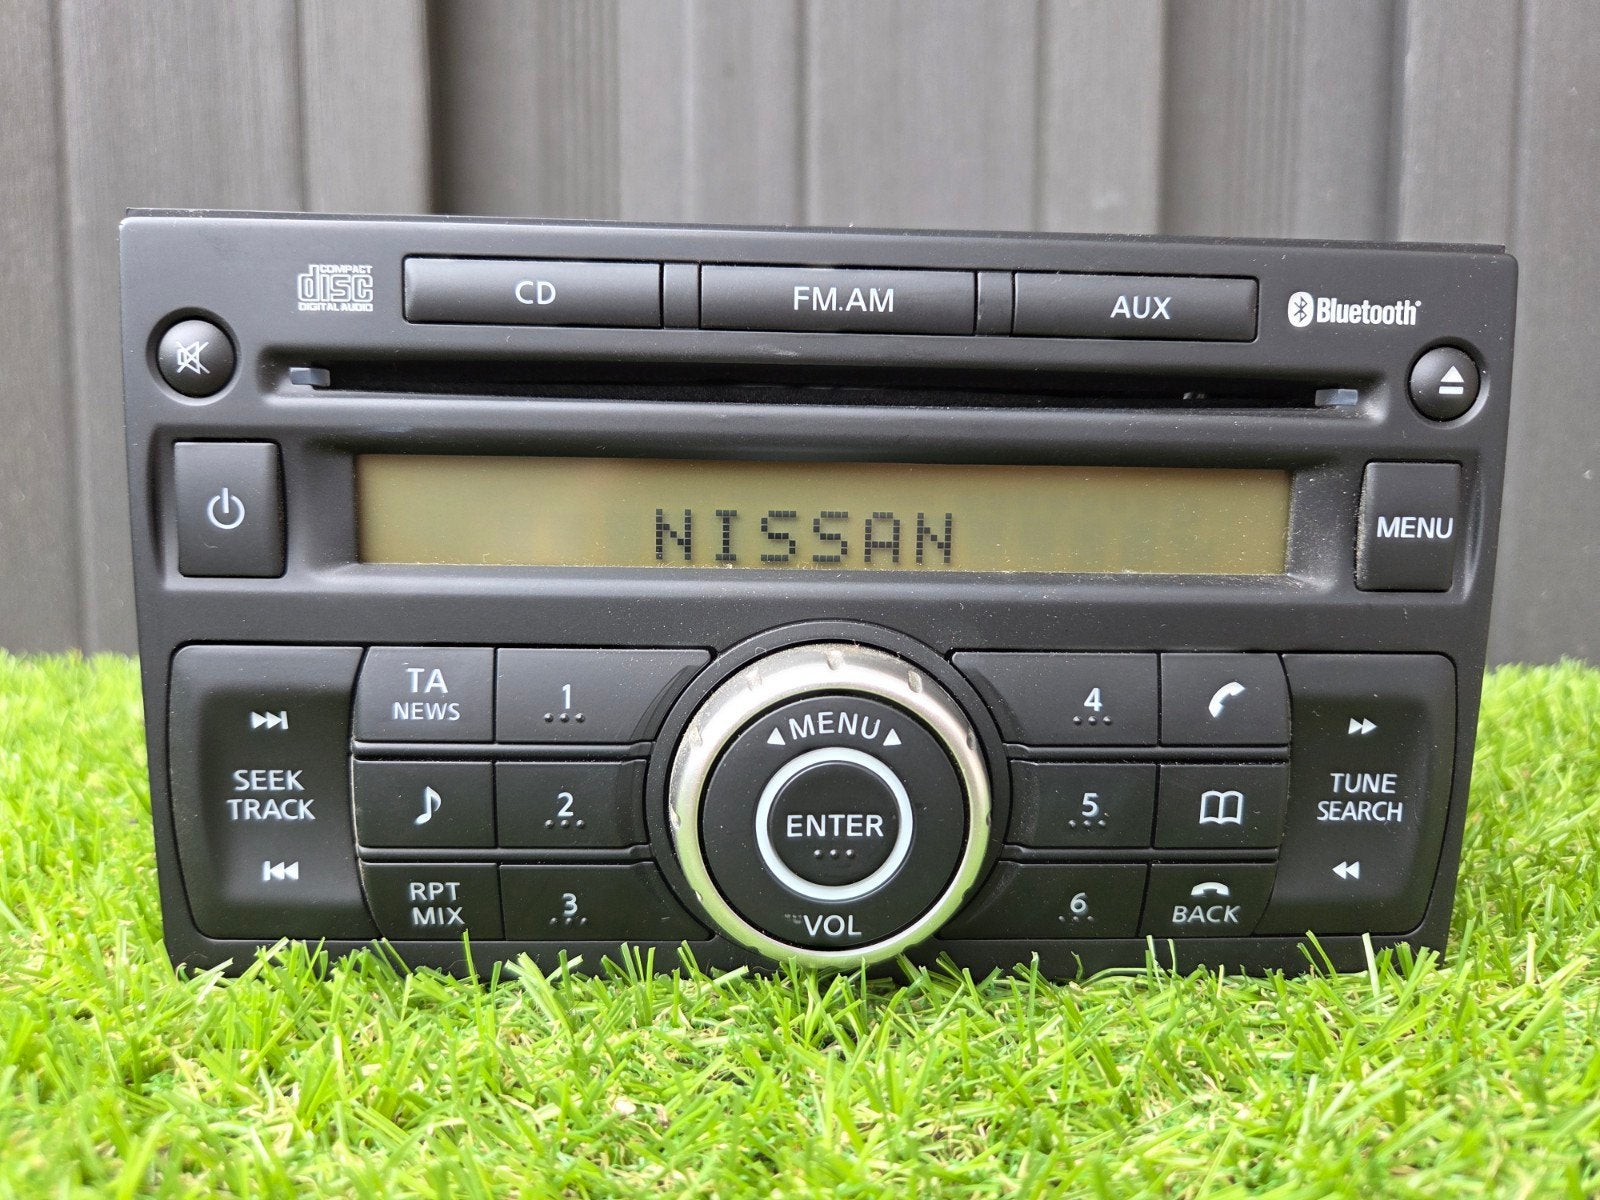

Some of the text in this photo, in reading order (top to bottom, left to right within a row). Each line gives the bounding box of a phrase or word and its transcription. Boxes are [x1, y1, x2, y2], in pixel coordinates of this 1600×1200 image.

[319, 264, 373, 273] COMPACT
[515, 280, 556, 306] CD
[793, 285, 895, 313] FM.AM
[297, 302, 374, 312] DIGITAL AUDIO
[1110, 295, 1171, 321] AUX
[1316, 297, 1418, 326] Bluetooth
[655, 508, 954, 564] NISSAN
[1376, 515, 1454, 540] MENU
[407, 667, 449, 695] TA
[561, 684, 573, 710] 1
[1083, 687, 1103, 712] 4
[392, 701, 461, 722] NEWS
[788, 711, 881, 741] MENU
[232, 769, 305, 792] SEEK
[1330, 772, 1398, 794] TUNE
[227, 799, 316, 822] TRACK
[557, 792, 574, 818] 2
[1081, 793, 1100, 818] 5
[1315, 800, 1404, 823] SEARCH
[785, 813, 885, 839] ENTER
[408, 882, 461, 902] RPT
[1069, 891, 1088, 914] 6
[411, 906, 465, 927] MIX
[562, 893, 578, 916] 3
[1171, 904, 1241, 926] BACK
[804, 914, 862, 938] VOL
